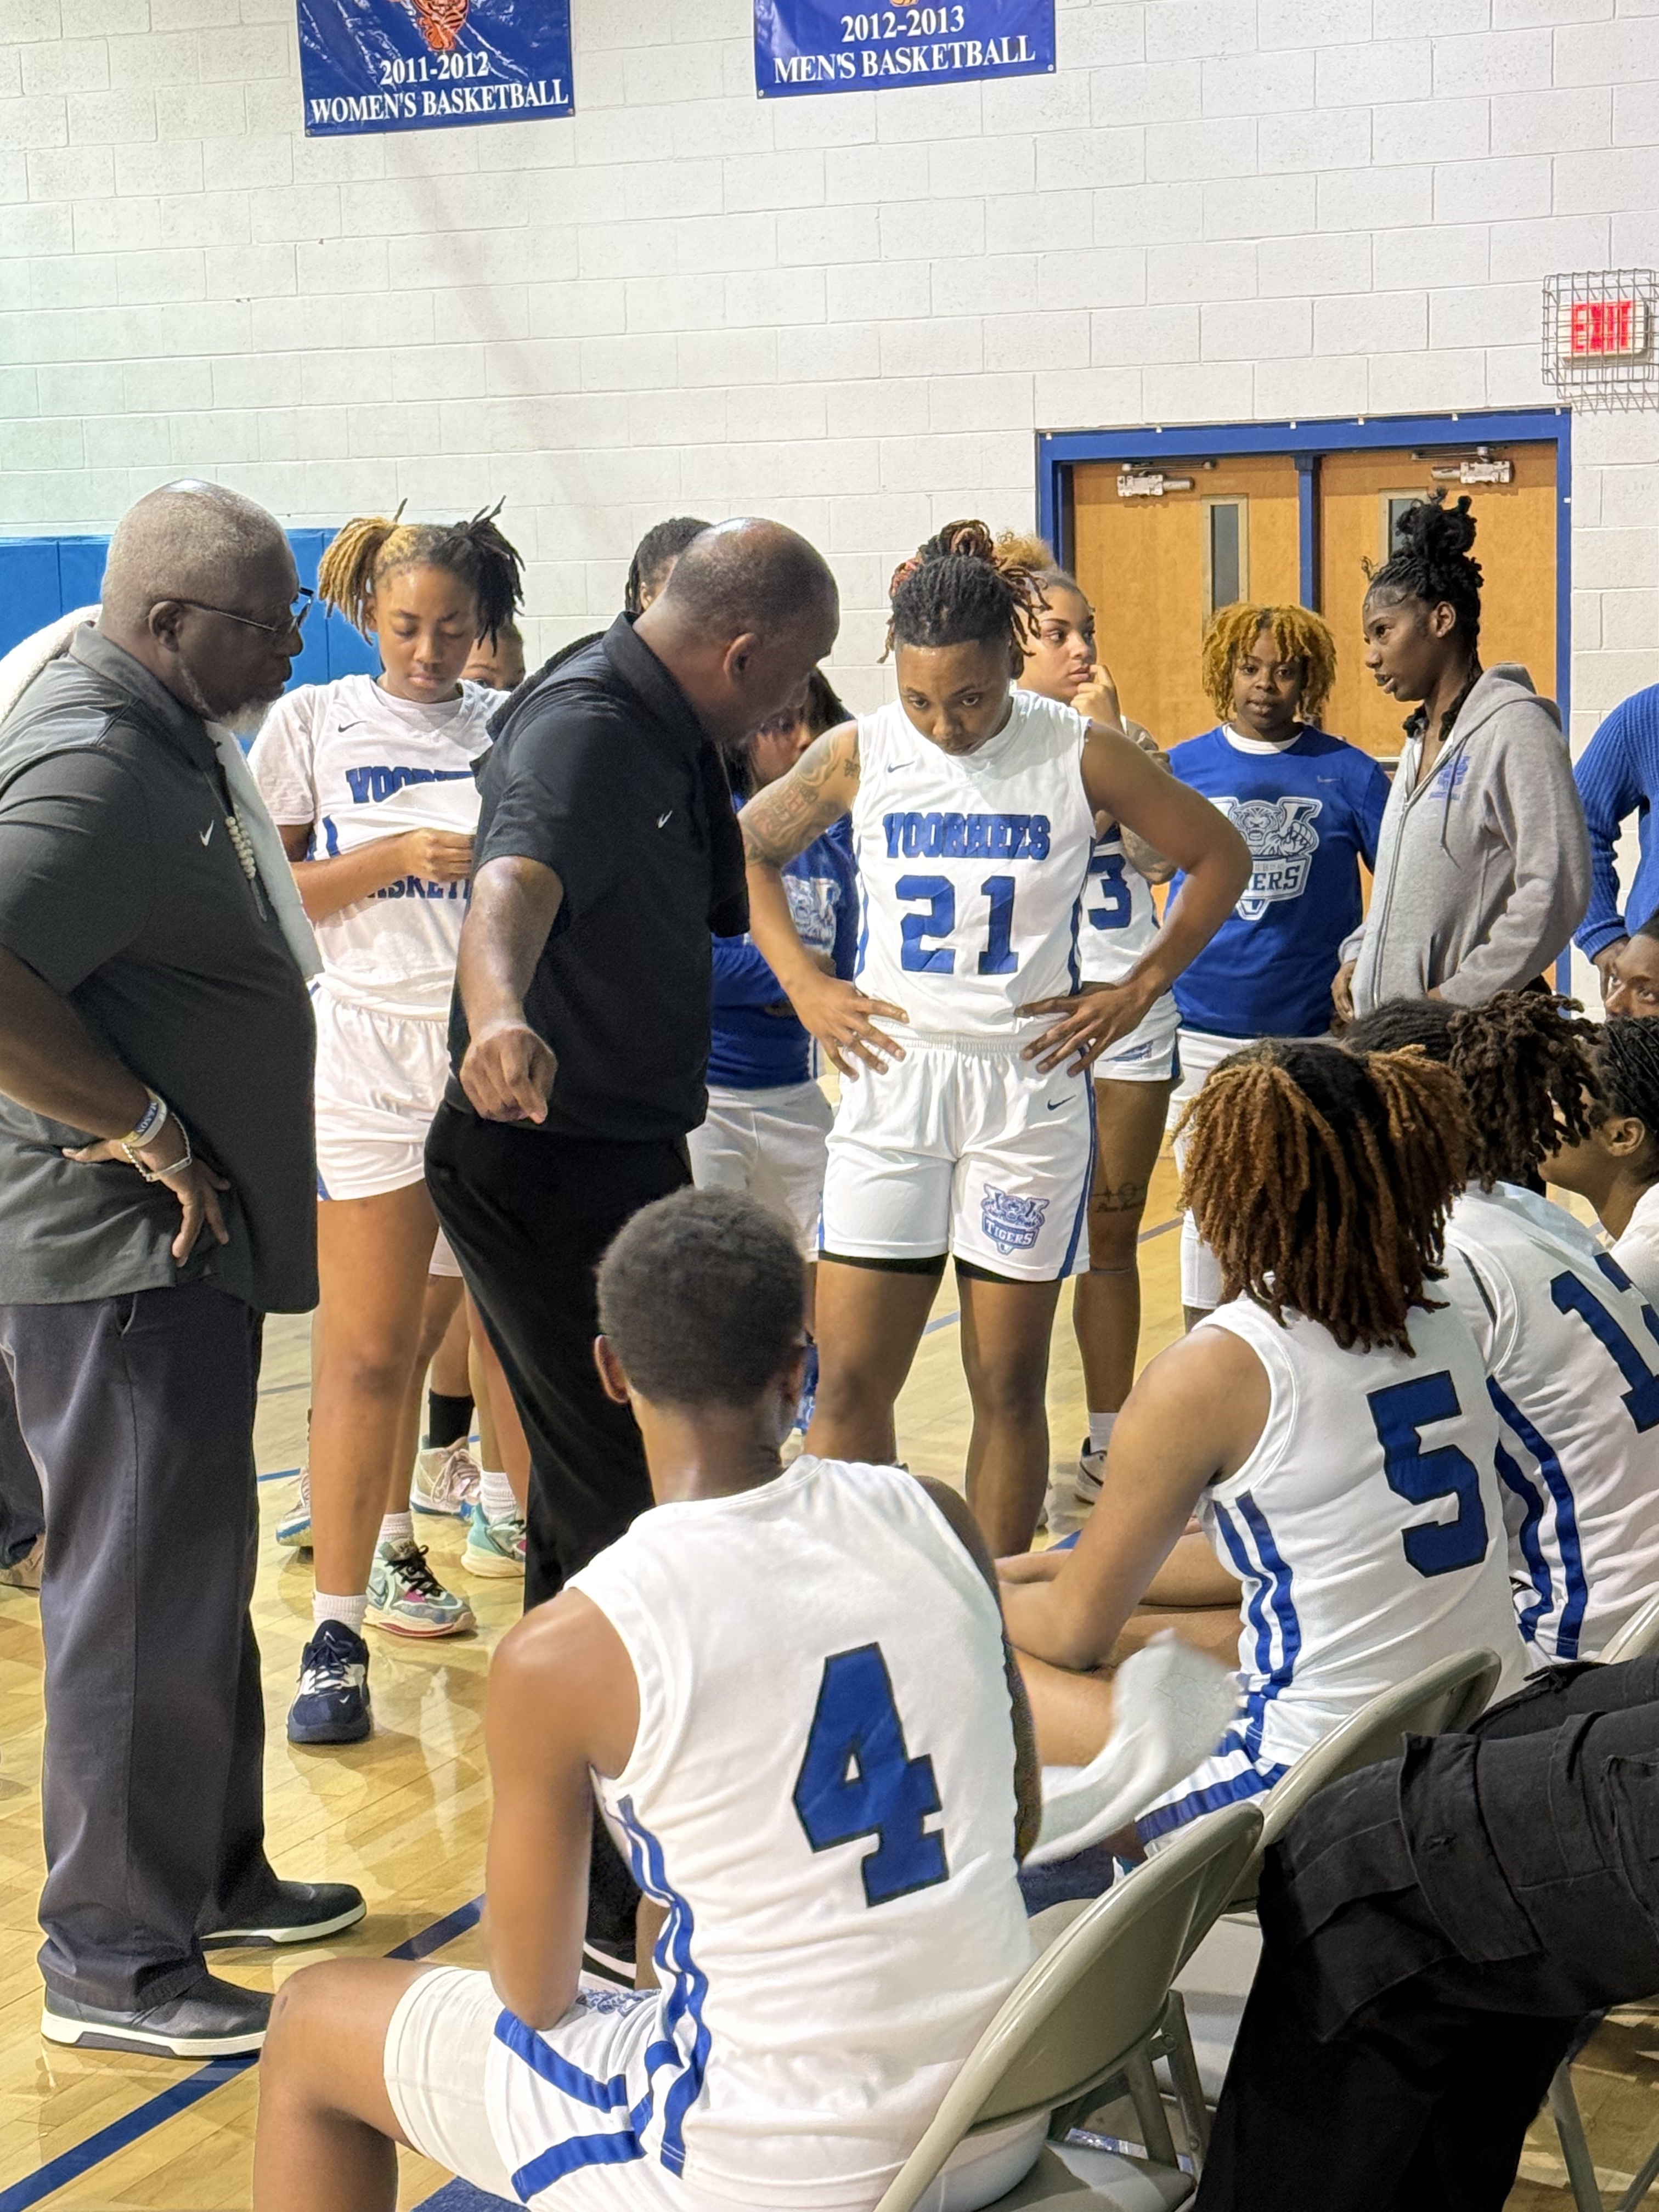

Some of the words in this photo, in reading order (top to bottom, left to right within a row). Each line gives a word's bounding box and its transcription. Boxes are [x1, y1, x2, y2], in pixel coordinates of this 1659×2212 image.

[840, 5, 964, 43] 2012-2013
[380, 52, 489, 85] 2011-2012
[774, 52, 856, 84] MEN'S
[861, 35, 1036, 78] BASKETBALL
[310, 92, 416, 124] WOMEN'S
[422, 78, 569, 116] BASKETBALL
[1571, 301, 1633, 352] EXIT
[882, 812, 1051, 860] VOORHEES
[895, 874, 1019, 975] 21
[986, 1218, 1034, 1245] TIGERS
[1367, 1369, 1489, 1578] 5
[792, 1641, 950, 1909] 4
